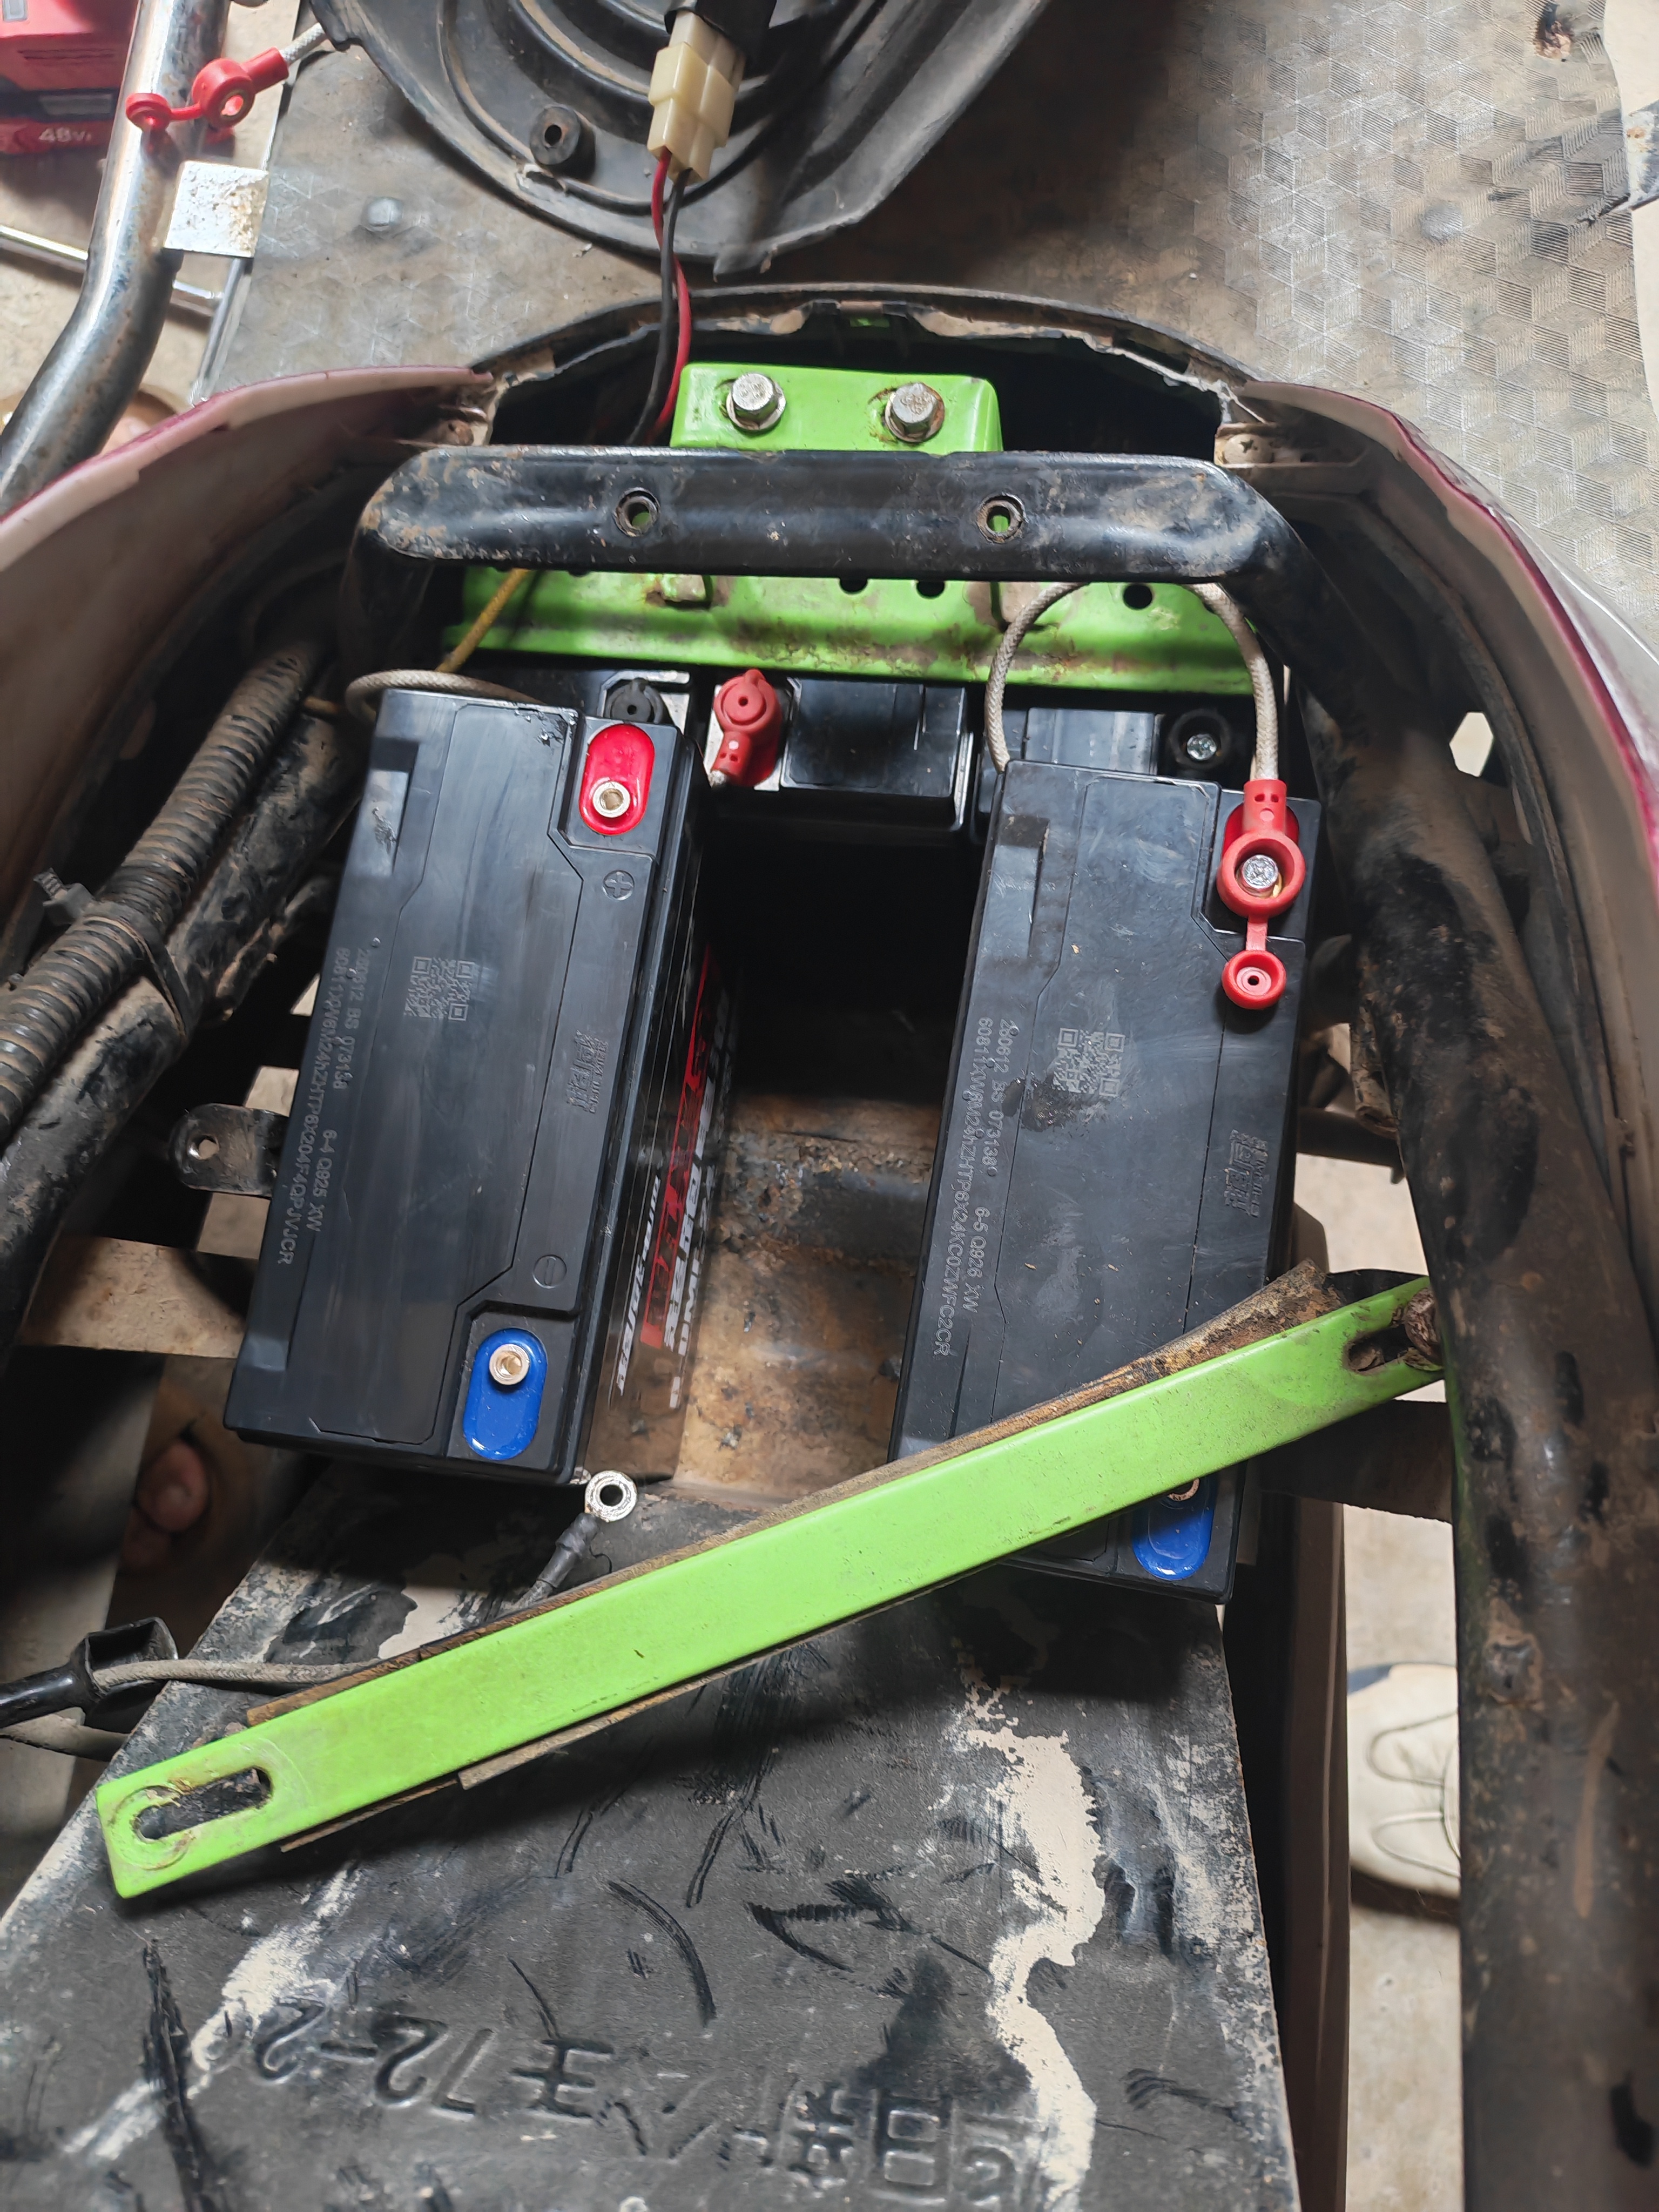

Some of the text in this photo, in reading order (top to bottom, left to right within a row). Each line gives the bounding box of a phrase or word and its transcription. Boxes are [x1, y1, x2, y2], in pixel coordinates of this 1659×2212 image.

[343, 1006, 362, 1031] BS
[331, 1034, 357, 1091] 073138
[988, 1079, 1008, 1104] BS
[319, 1128, 339, 1155] 6-4
[979, 1109, 1007, 1168] 073138
[305, 1202, 326, 1232] XW
[971, 1205, 993, 1234] 6-5
[966, 1235, 988, 1279] Q926
[960, 1282, 983, 1314] XW
